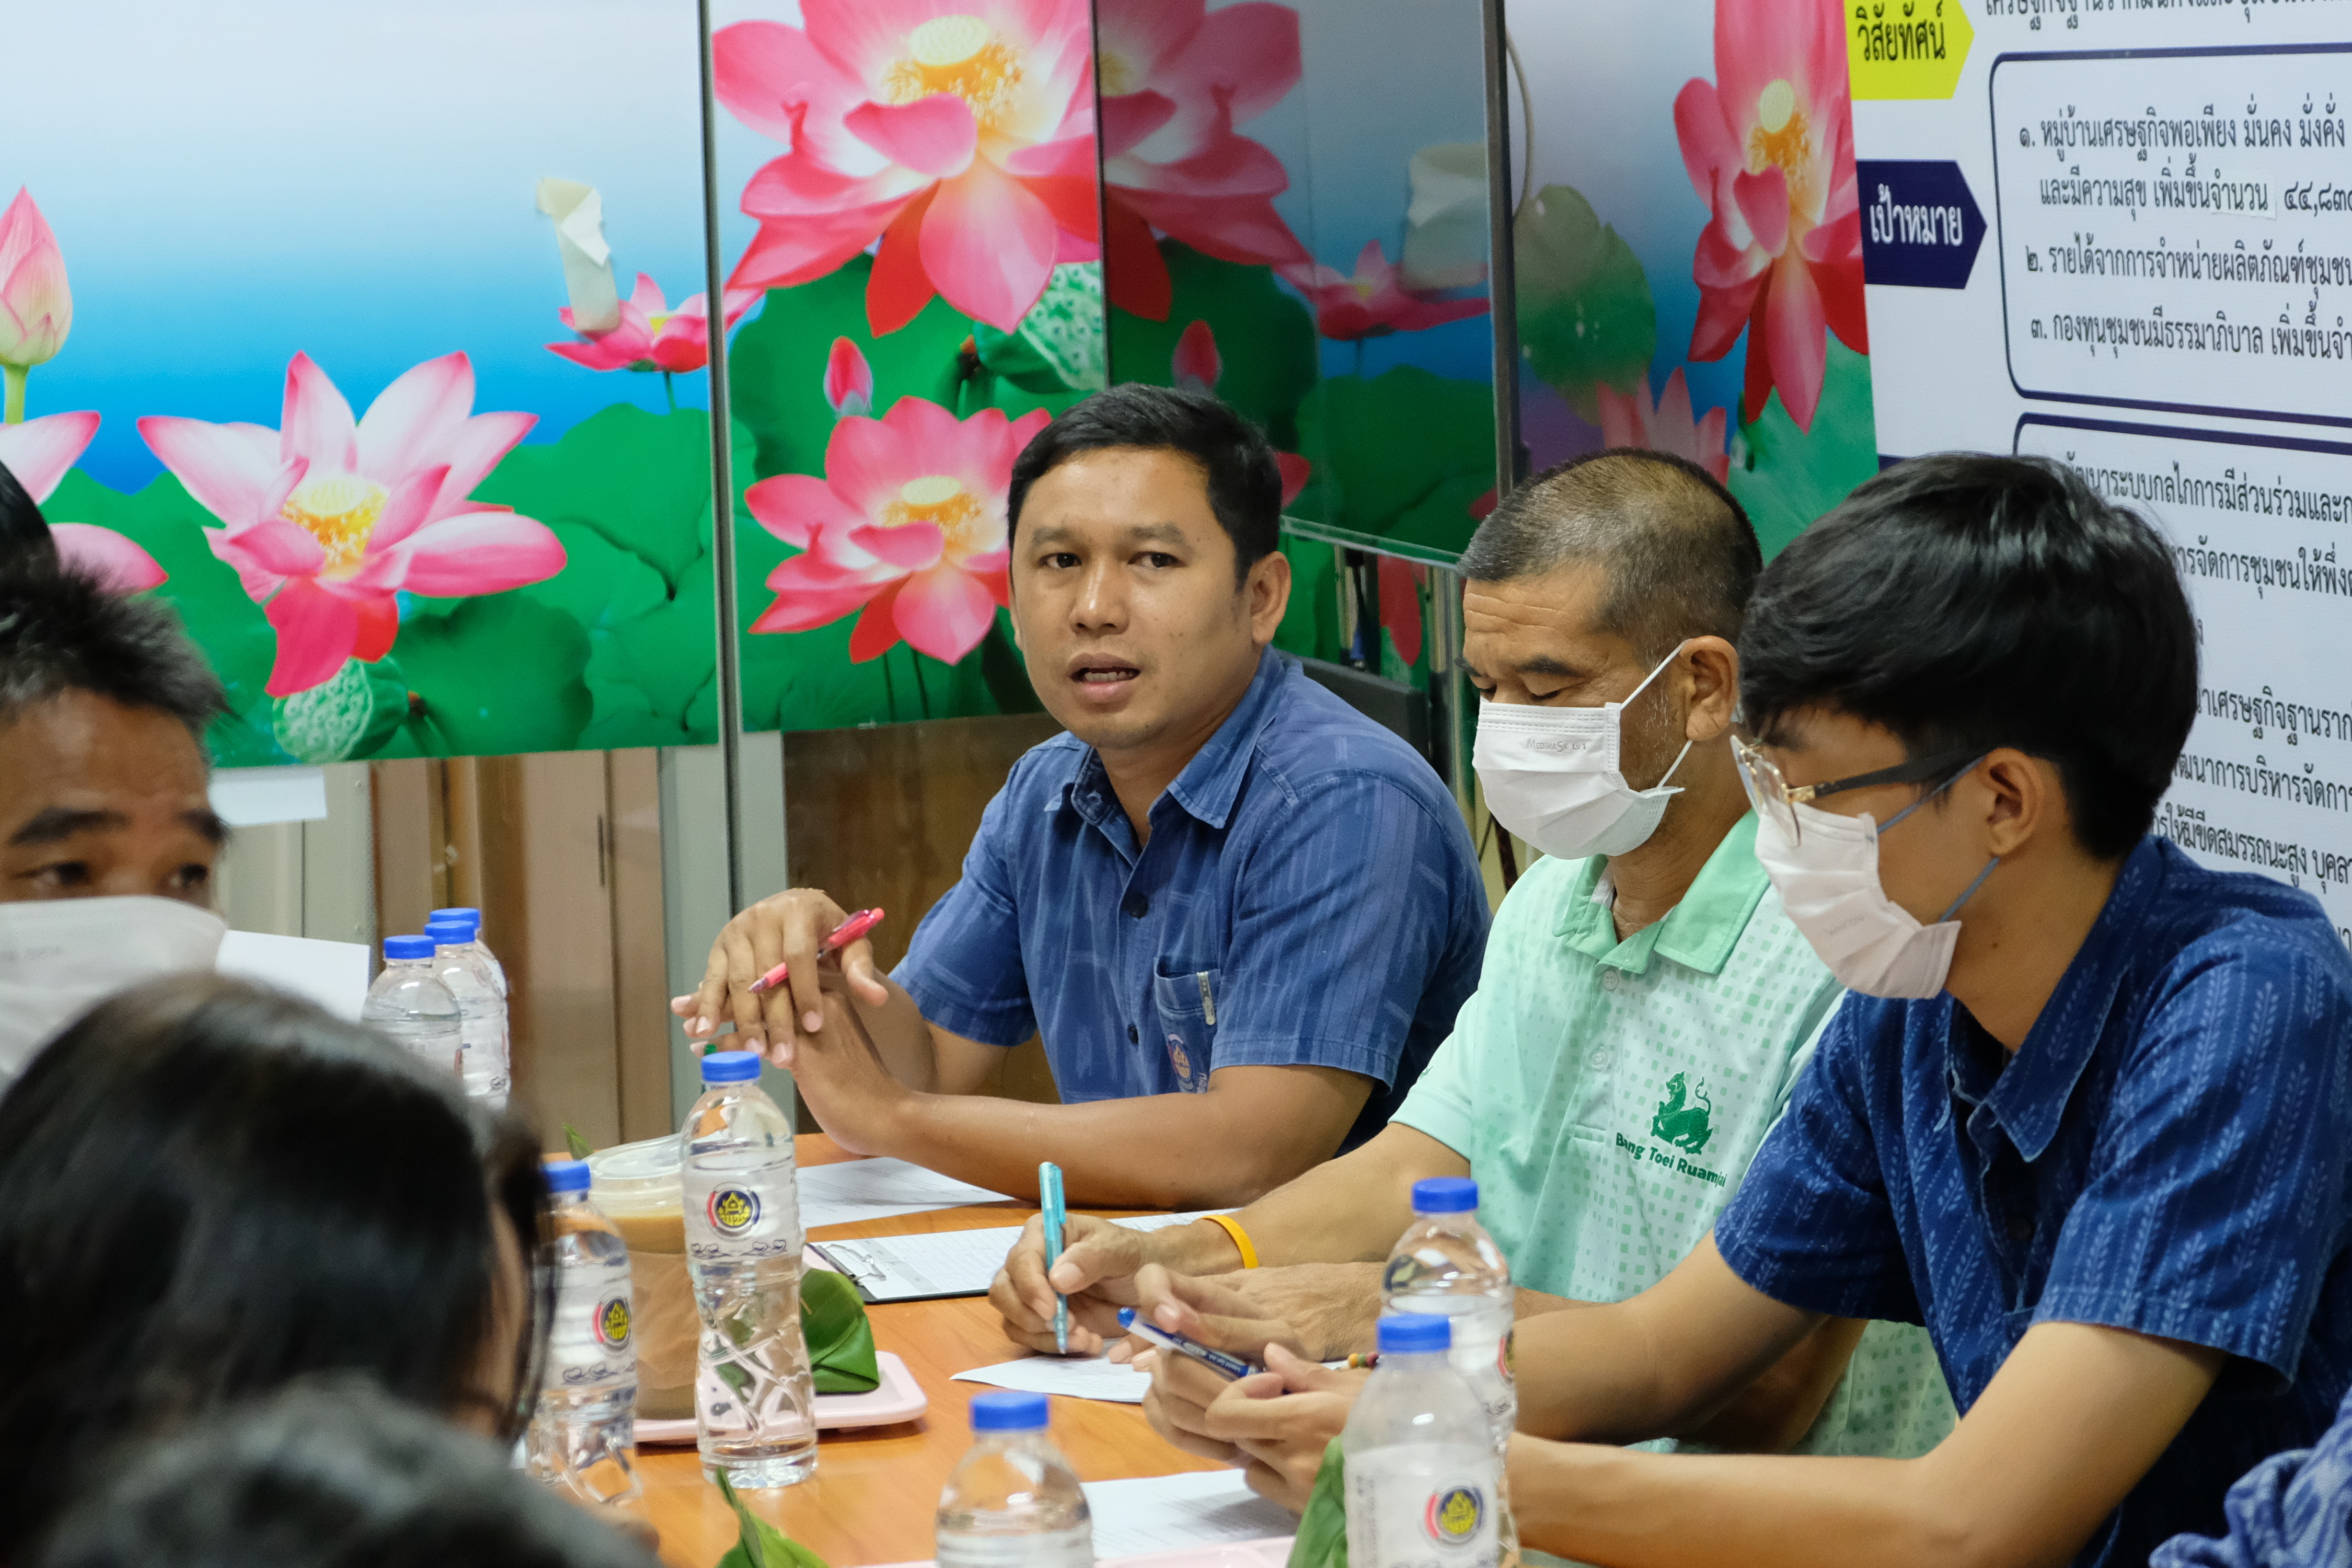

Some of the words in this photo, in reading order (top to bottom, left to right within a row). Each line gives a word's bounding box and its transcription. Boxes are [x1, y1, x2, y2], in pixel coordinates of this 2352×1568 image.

[1856, 0, 1946, 61] วิสัยทัศน์
[2041, 103, 2236, 162] หมู่บ้านเศรษฐกิจพอเพียง
[2244, 93, 2292, 147] มั่นคง
[2299, 92, 2345, 147] มั่งคั่ง
[1870, 183, 1963, 247] เป้าหมาย
[2040, 164, 2147, 221] และมีความสุข
[2054, 305, 2263, 359] กองทุนชุมชนมีธรรมาภิบาล
[1616, 1132, 1645, 1160] Bang
[1648, 1146, 1675, 1169] Toei
